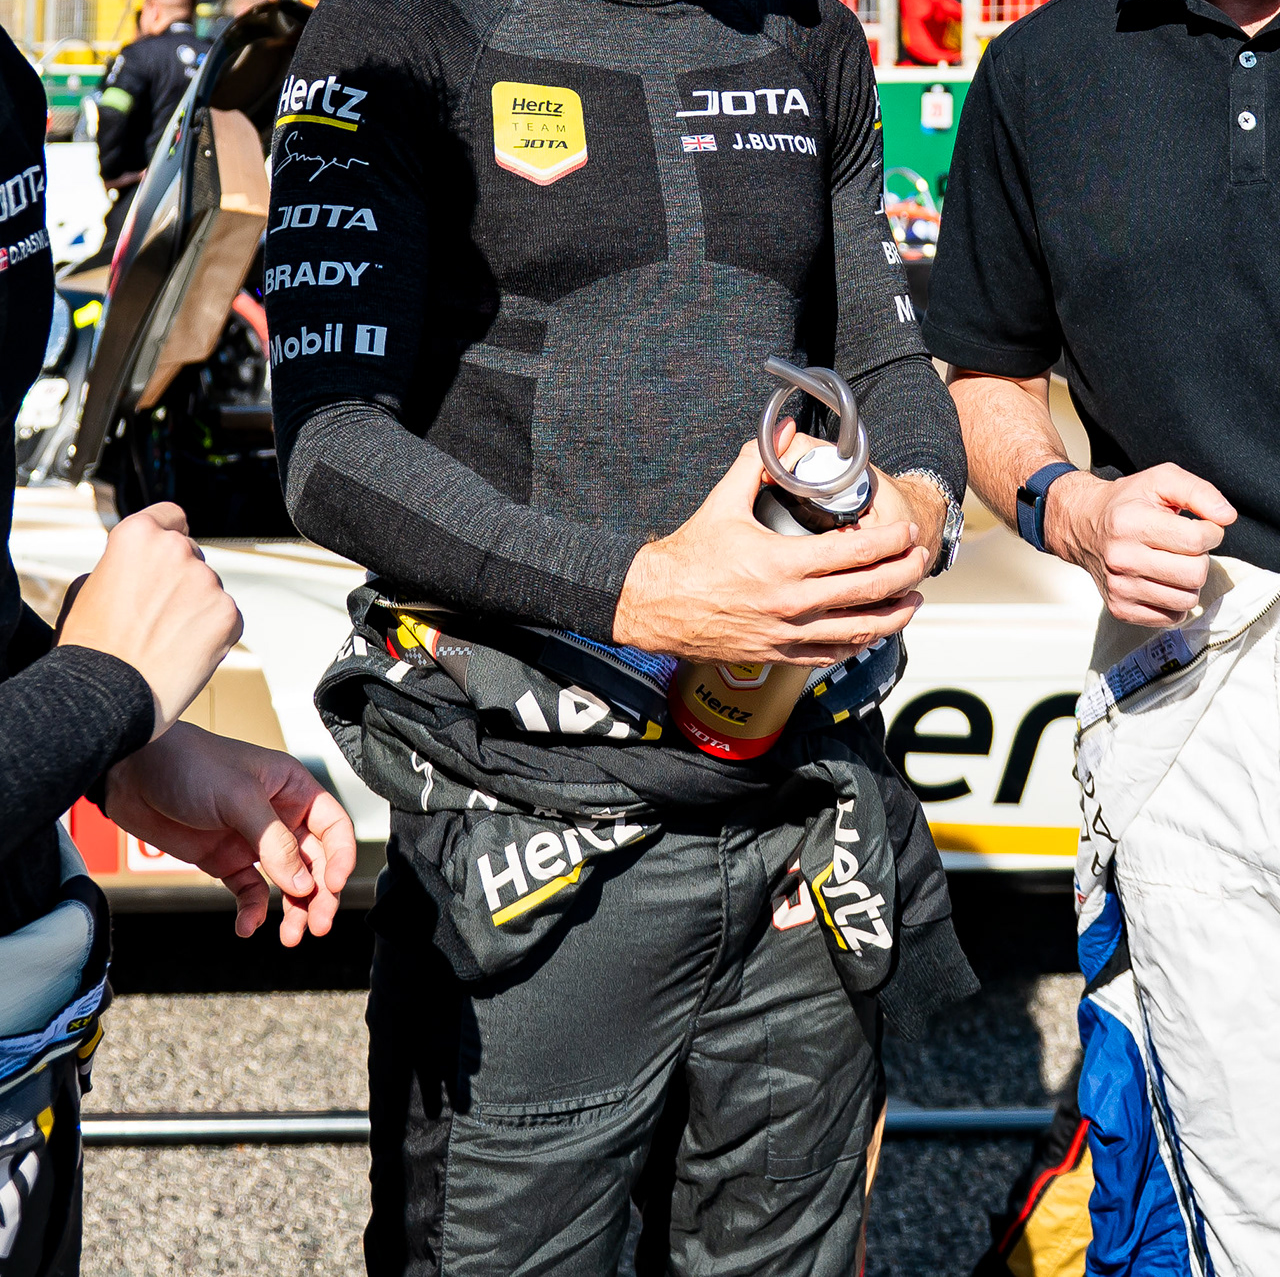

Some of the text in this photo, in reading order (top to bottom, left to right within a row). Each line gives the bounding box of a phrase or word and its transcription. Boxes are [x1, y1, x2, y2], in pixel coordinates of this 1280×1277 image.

[277, 75, 368, 121] Hertz
[512, 98, 565, 113] Hertz
[676, 88, 810, 117] JOTA
[512, 123, 566, 132] TEAM
[274, 131, 370, 183] Singer
[514, 139, 568, 149] JOTA
[732, 132, 818, 156] J.BUTTON
[269, 204, 378, 235] JOTA
[265, 261, 370, 296] BRADY
[271, 323, 387, 369] Mobil 1
[694, 684, 753, 724] Hertz
[683, 722, 731, 753] JOTA
